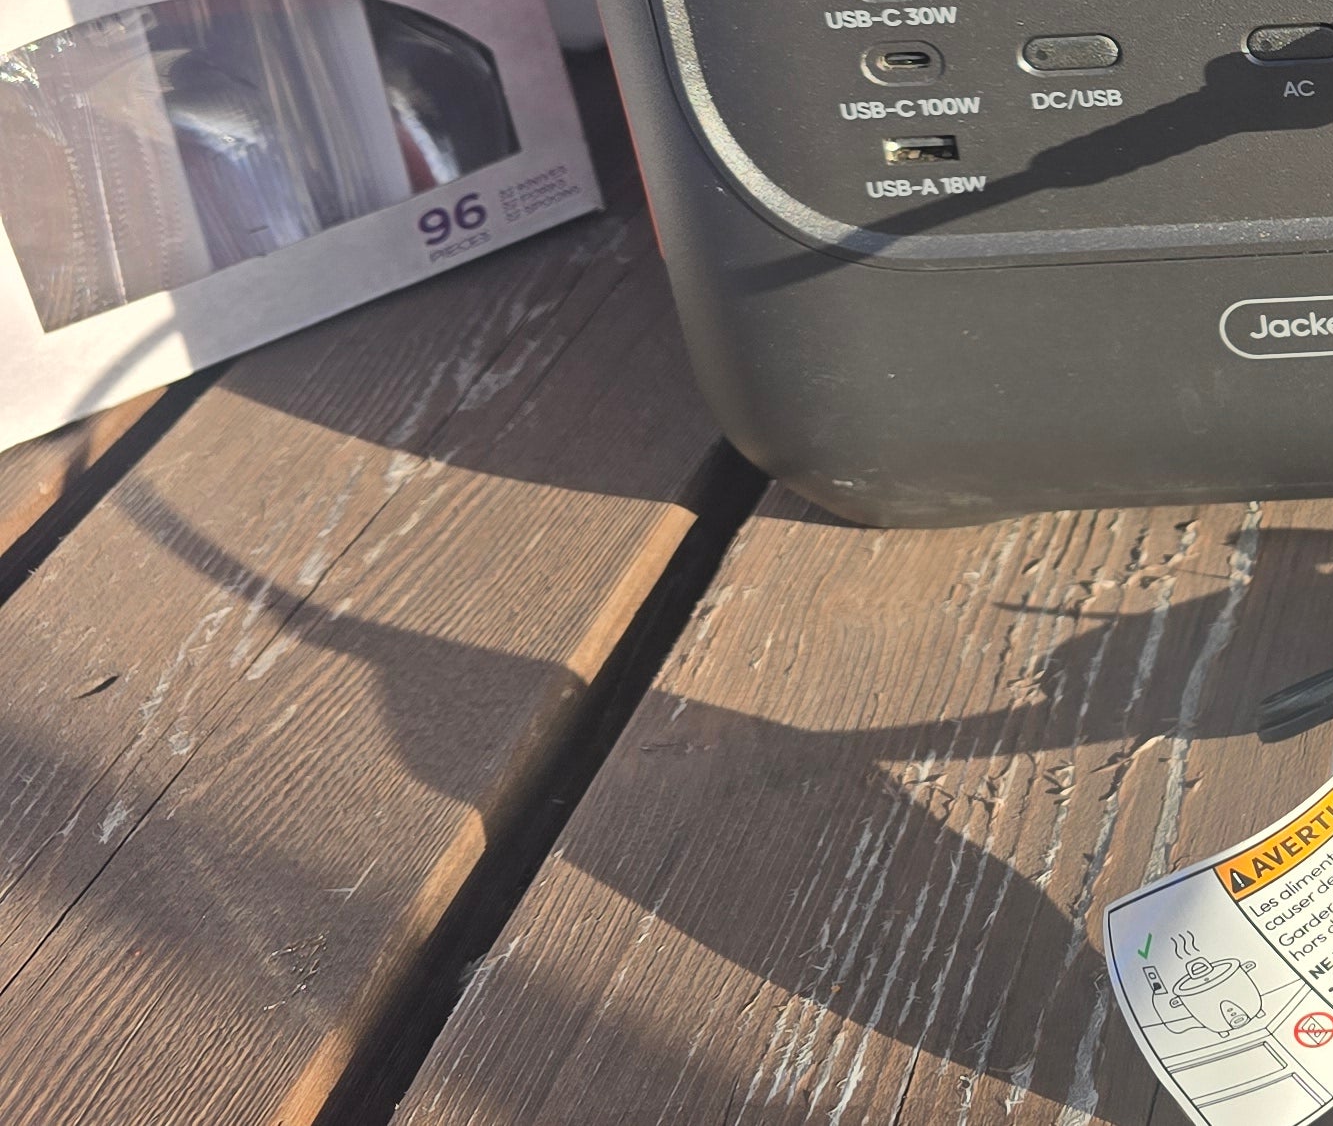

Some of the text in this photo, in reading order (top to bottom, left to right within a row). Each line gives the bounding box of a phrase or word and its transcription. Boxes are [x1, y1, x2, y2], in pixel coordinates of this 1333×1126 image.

[825, 5, 957, 30] USB-C 30W
[1031, 89, 1123, 111] DC/USB
[1283, 79, 1316, 99] AC
[840, 95, 980, 122] USB-C 100W
[866, 174, 986, 200] USB-A 18W
[418, 192, 488, 247] 96
[1249, 897, 1279, 918] Les
[1265, 892, 1315, 931] causer
[1279, 902, 1333, 947] Garder
[1289, 934, 1327, 961] hors
